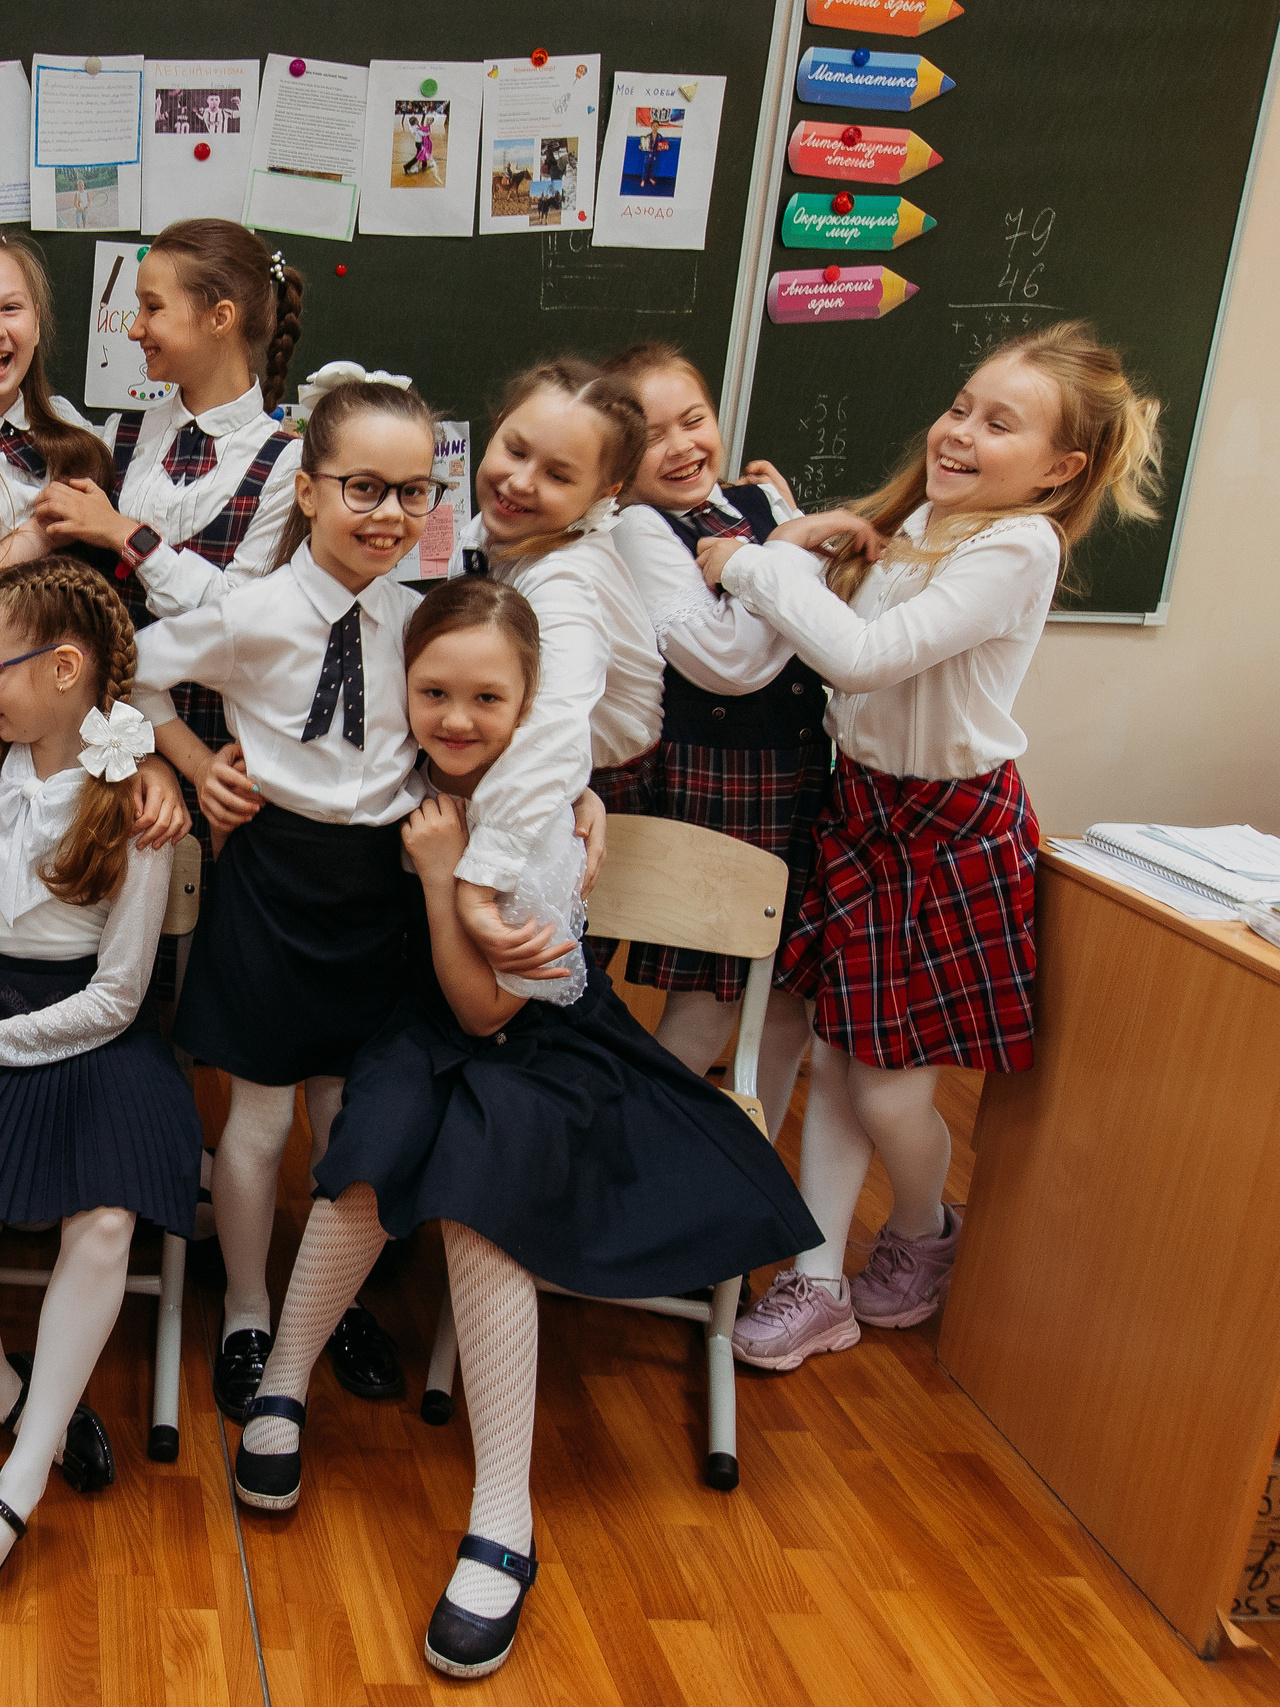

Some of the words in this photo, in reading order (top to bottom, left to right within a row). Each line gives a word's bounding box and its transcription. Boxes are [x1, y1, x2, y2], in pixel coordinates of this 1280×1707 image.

[807, 63, 919, 89] Математика
[825, 154, 875, 169] чтение
[621, 204, 675, 219] ДЗЮДО
[793, 207, 900, 231] Окружающий
[825, 226, 861, 245] мир
[1005, 207, 1056, 257] 79
[781, 278, 875, 296] Английский
[997, 262, 1045, 301] 46
[808, 296, 845, 315] язык
[97, 309, 138, 333] ИСК
[815, 427, 846, 456] 36
